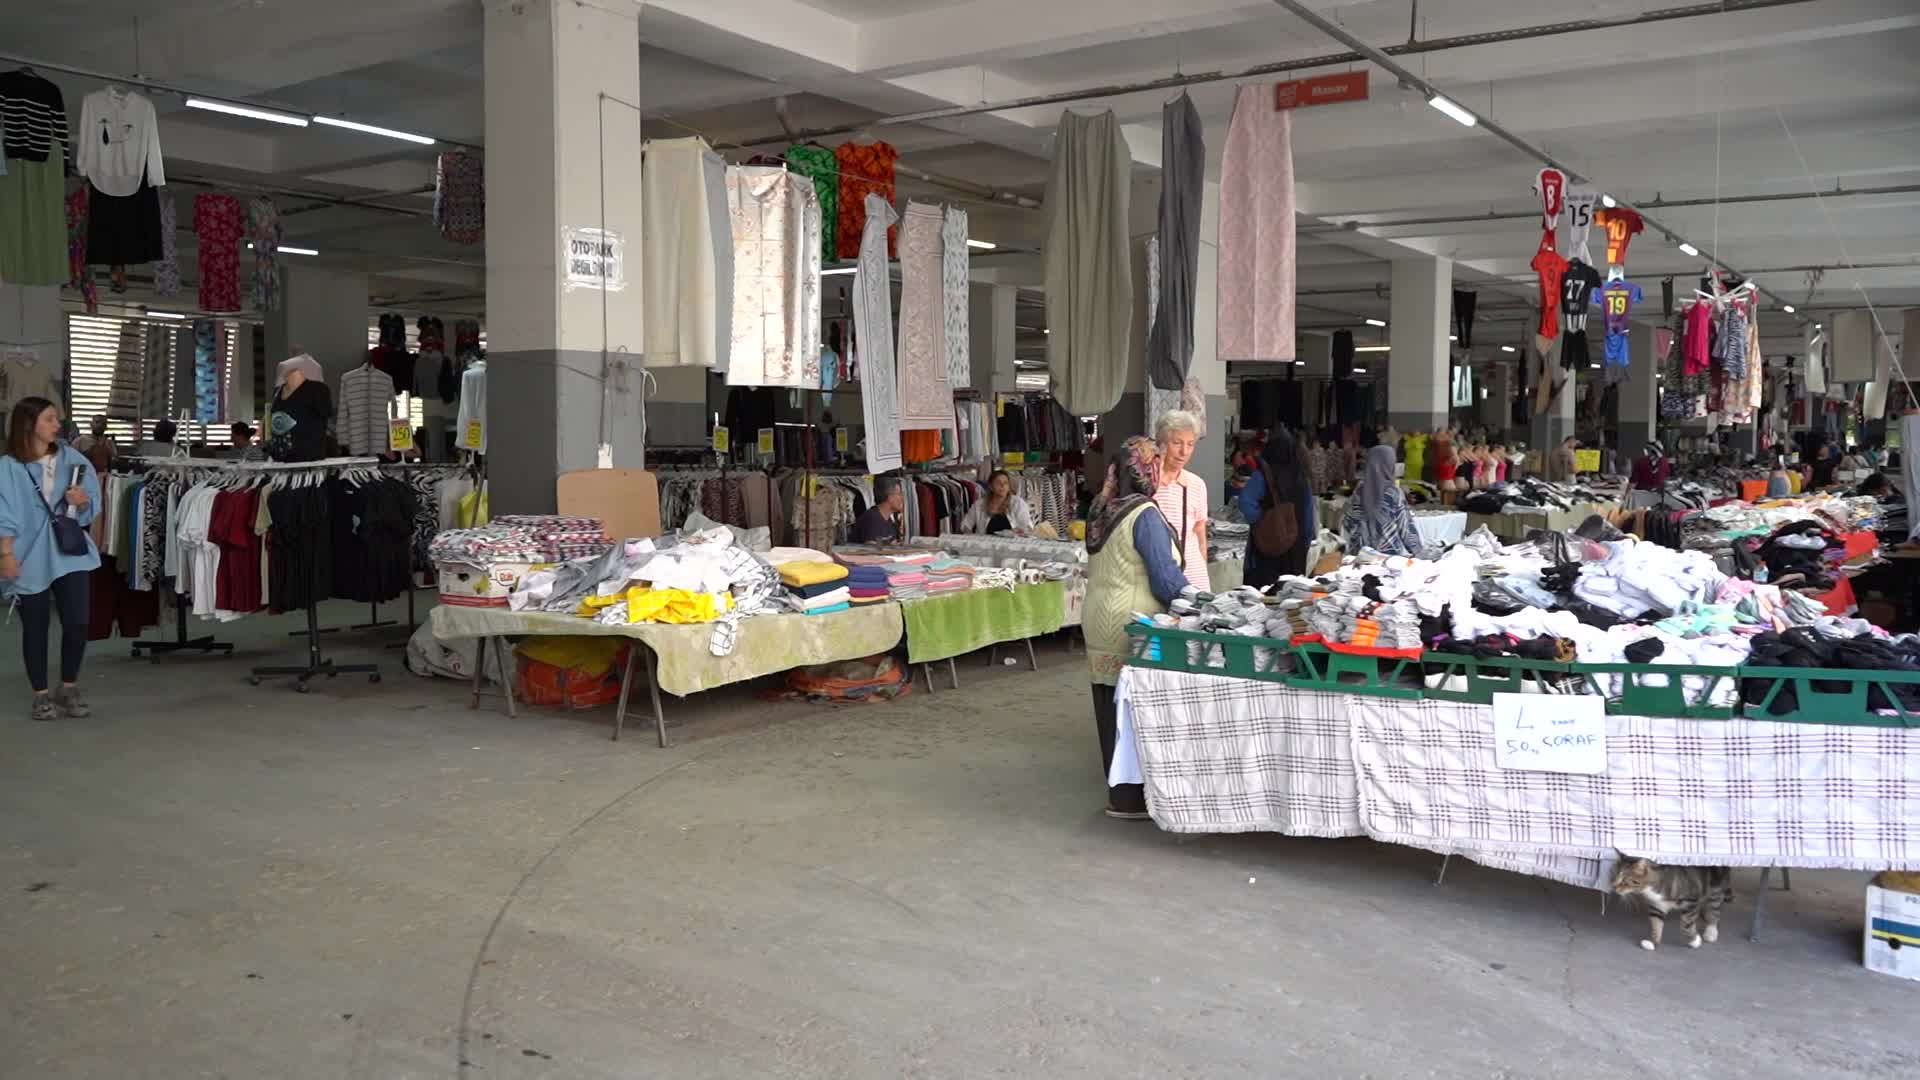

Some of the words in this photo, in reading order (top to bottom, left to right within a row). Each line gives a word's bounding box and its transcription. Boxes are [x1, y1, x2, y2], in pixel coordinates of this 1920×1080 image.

[1569, 204, 1590, 226] 15
[1607, 219, 1627, 241] 10
[1566, 279, 1585, 300] 27
[1607, 296, 1626, 315] 19
